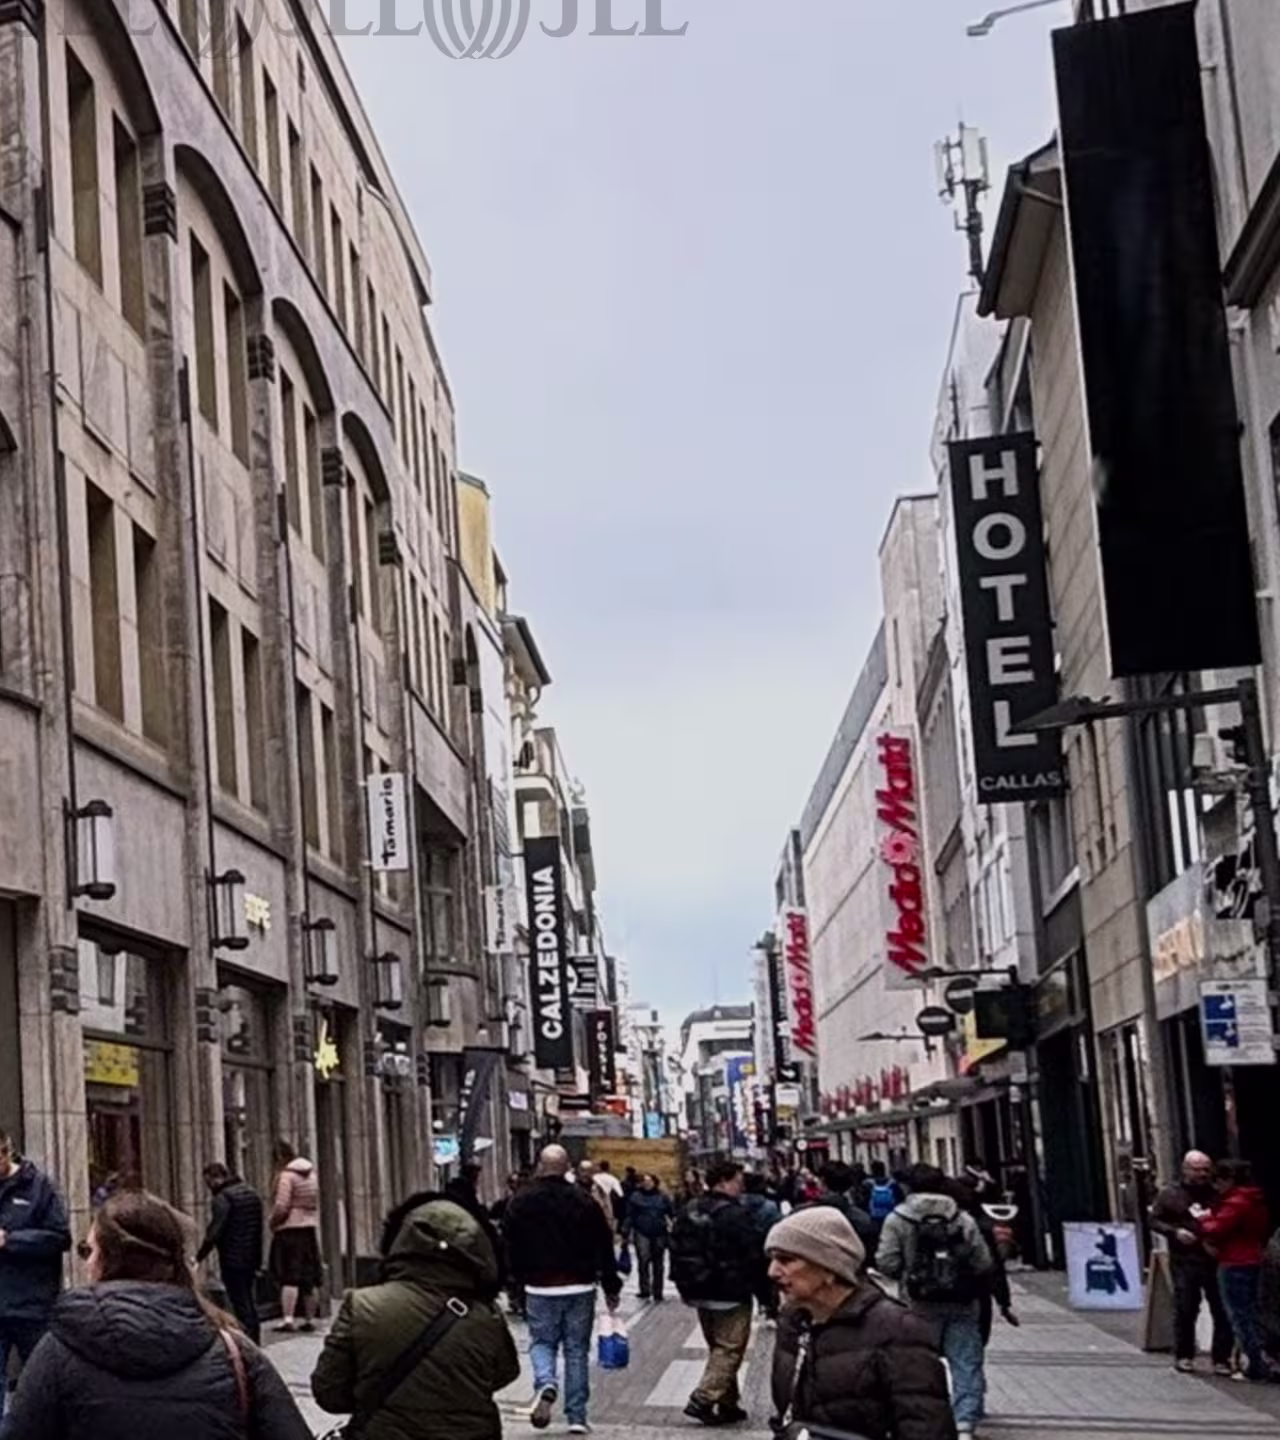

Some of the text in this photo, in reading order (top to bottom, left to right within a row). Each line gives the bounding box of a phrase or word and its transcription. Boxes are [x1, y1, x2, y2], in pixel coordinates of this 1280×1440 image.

[969, 450, 1038, 747] HOTEL
[380, 778, 397, 865] Tamaris
[980, 771, 1061, 790] CALLAS
[533, 866, 563, 1039] CALZEDONIA
